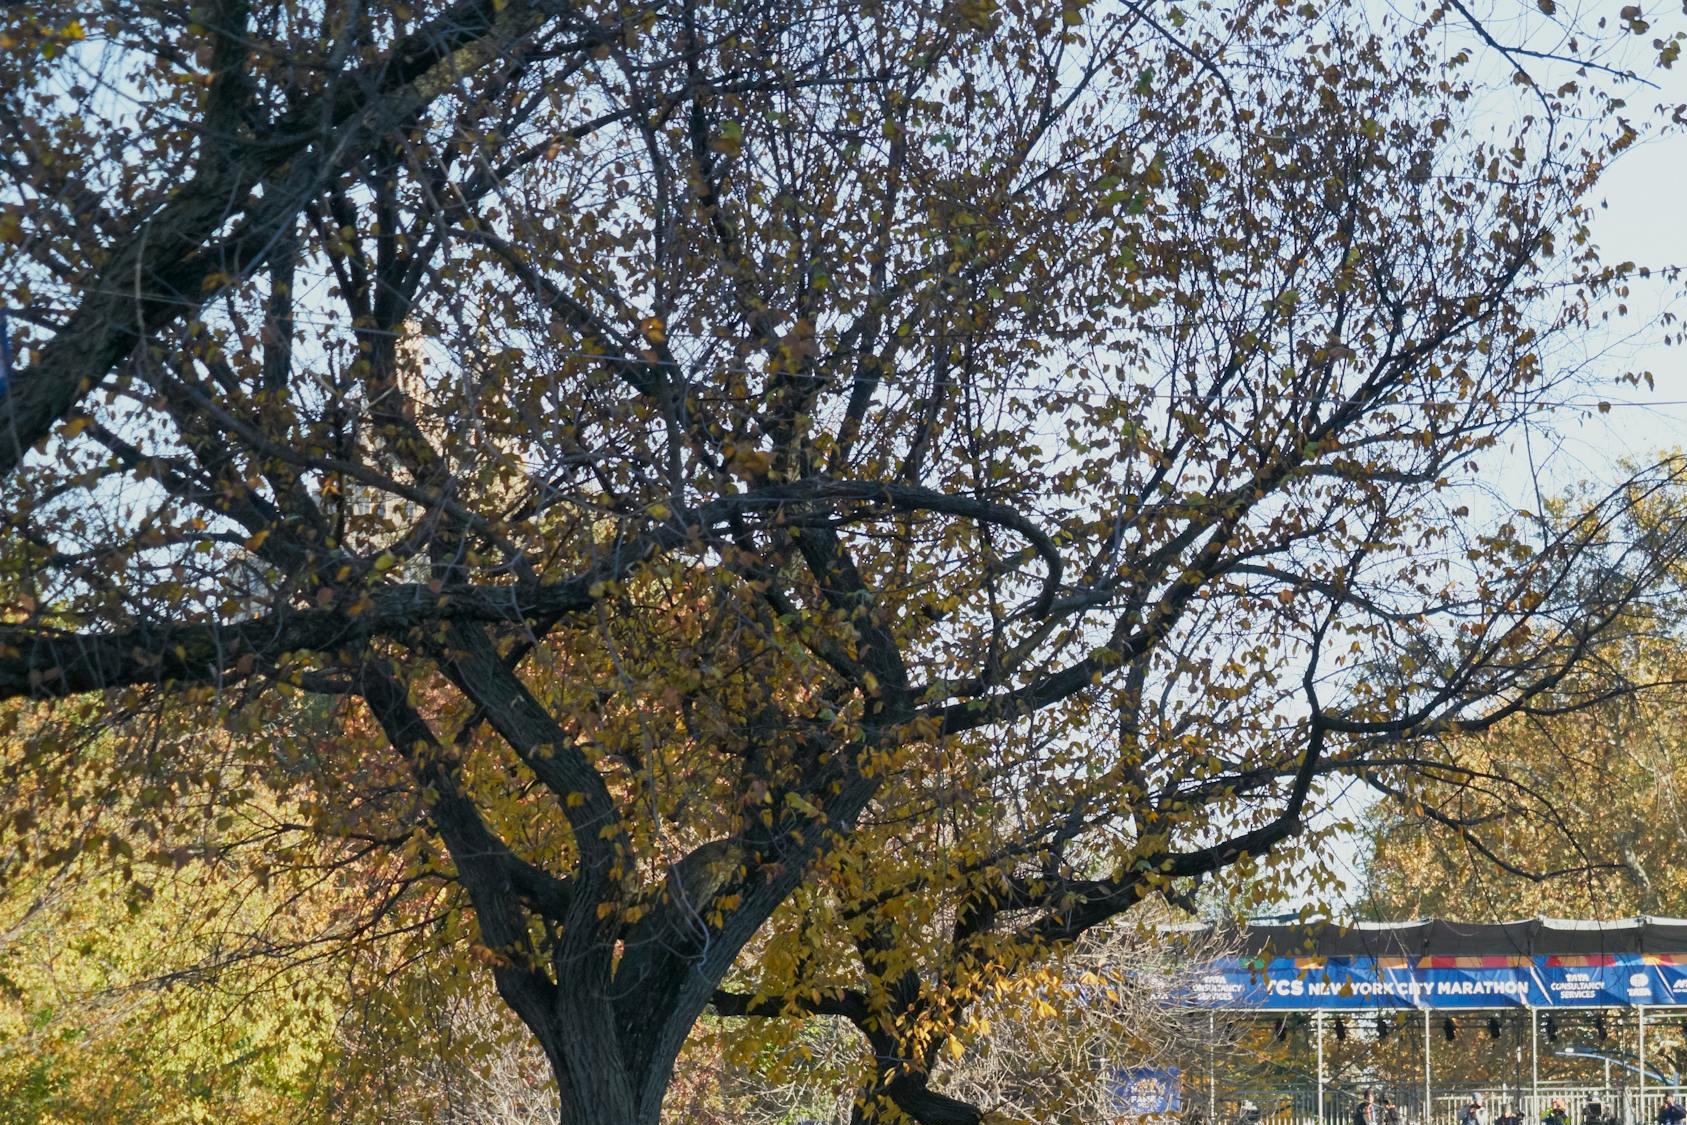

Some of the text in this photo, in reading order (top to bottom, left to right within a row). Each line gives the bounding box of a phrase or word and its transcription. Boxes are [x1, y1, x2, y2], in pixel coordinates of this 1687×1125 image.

[1565, 974, 1590, 982] TATA
[1350, 983, 1395, 995] YORK
[1397, 982, 1433, 995] CITY
[1437, 979, 1529, 995] MARATHON
[1551, 981, 1604, 991] CONSULTANCY
[1560, 990, 1596, 999] SERVICES
[1628, 988, 1652, 996] TATA
